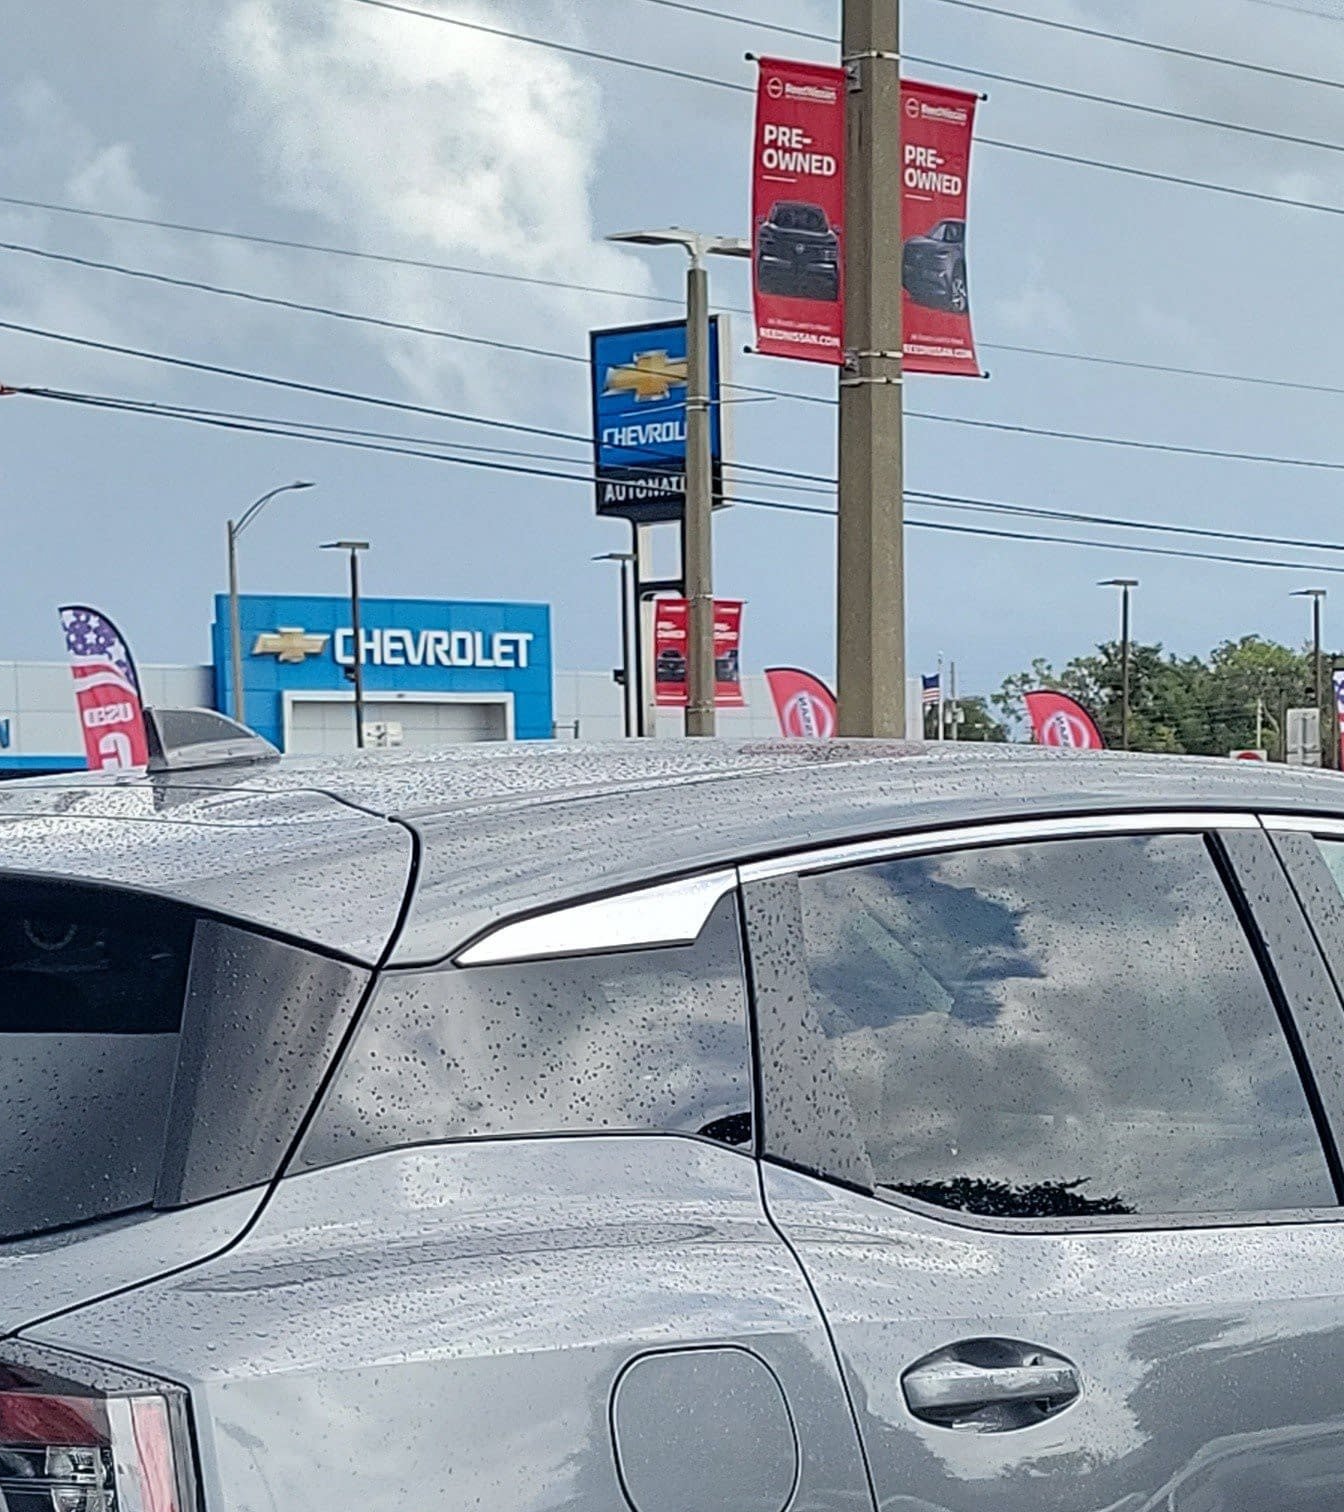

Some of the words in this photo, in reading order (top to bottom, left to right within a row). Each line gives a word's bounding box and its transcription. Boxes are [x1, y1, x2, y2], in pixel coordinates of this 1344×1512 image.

[764, 124, 813, 150] PRE-
[762, 147, 837, 177] OWNED
[904, 144, 945, 169] PRE-
[904, 167, 962, 196] OWNED
[602, 421, 688, 448] CHEVROL
[605, 475, 687, 502] AUTONATI
[333, 627, 534, 668] CHEVROLET
